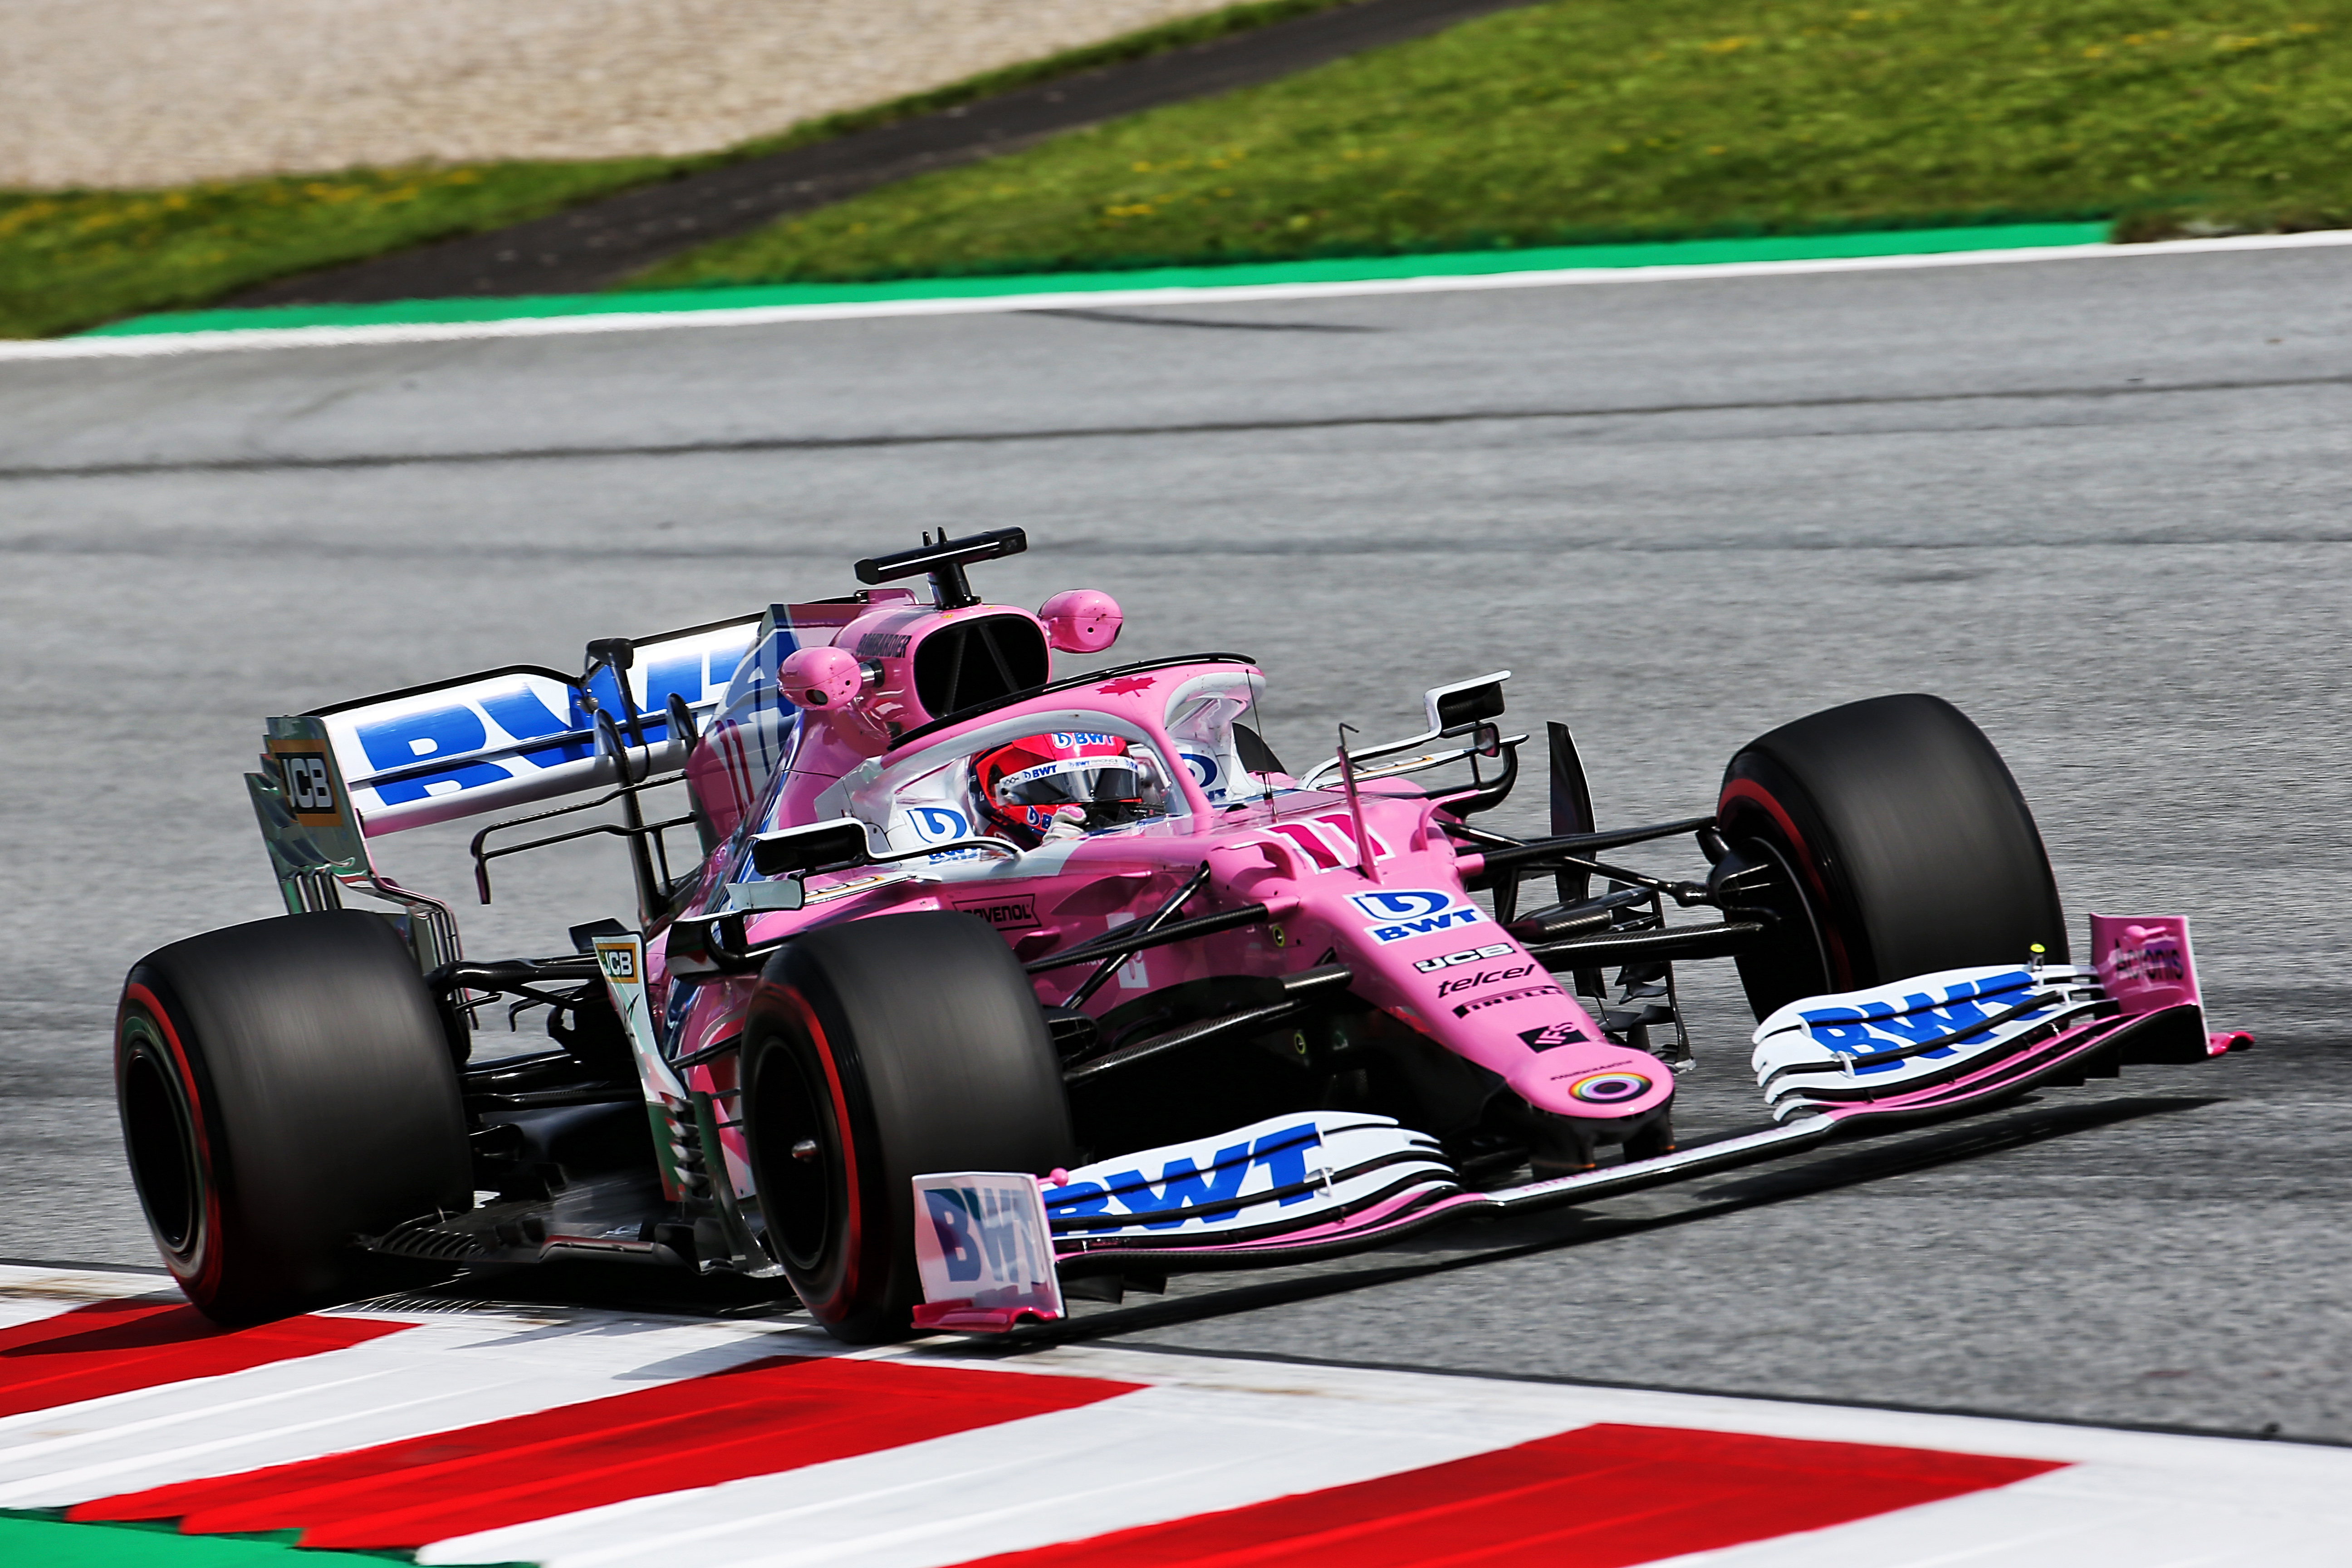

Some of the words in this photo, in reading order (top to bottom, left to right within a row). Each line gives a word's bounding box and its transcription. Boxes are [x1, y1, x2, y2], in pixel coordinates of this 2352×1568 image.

[856, 633, 912, 658] BOMBARDIER
[281, 758, 333, 808] JCB
[1032, 764, 1057, 778] BWT
[1257, 812, 1392, 874] 11
[1373, 908, 1477, 941] BWT
[604, 952, 633, 975] JCB
[1415, 943, 1514, 972] JCB
[2114, 938, 2183, 980] Acronis
[1438, 964, 1535, 998] telcel
[1798, 970, 2054, 1075] BWT
[1037, 1122, 1321, 1237] BWT
[923, 1187, 1040, 1283] BWT
